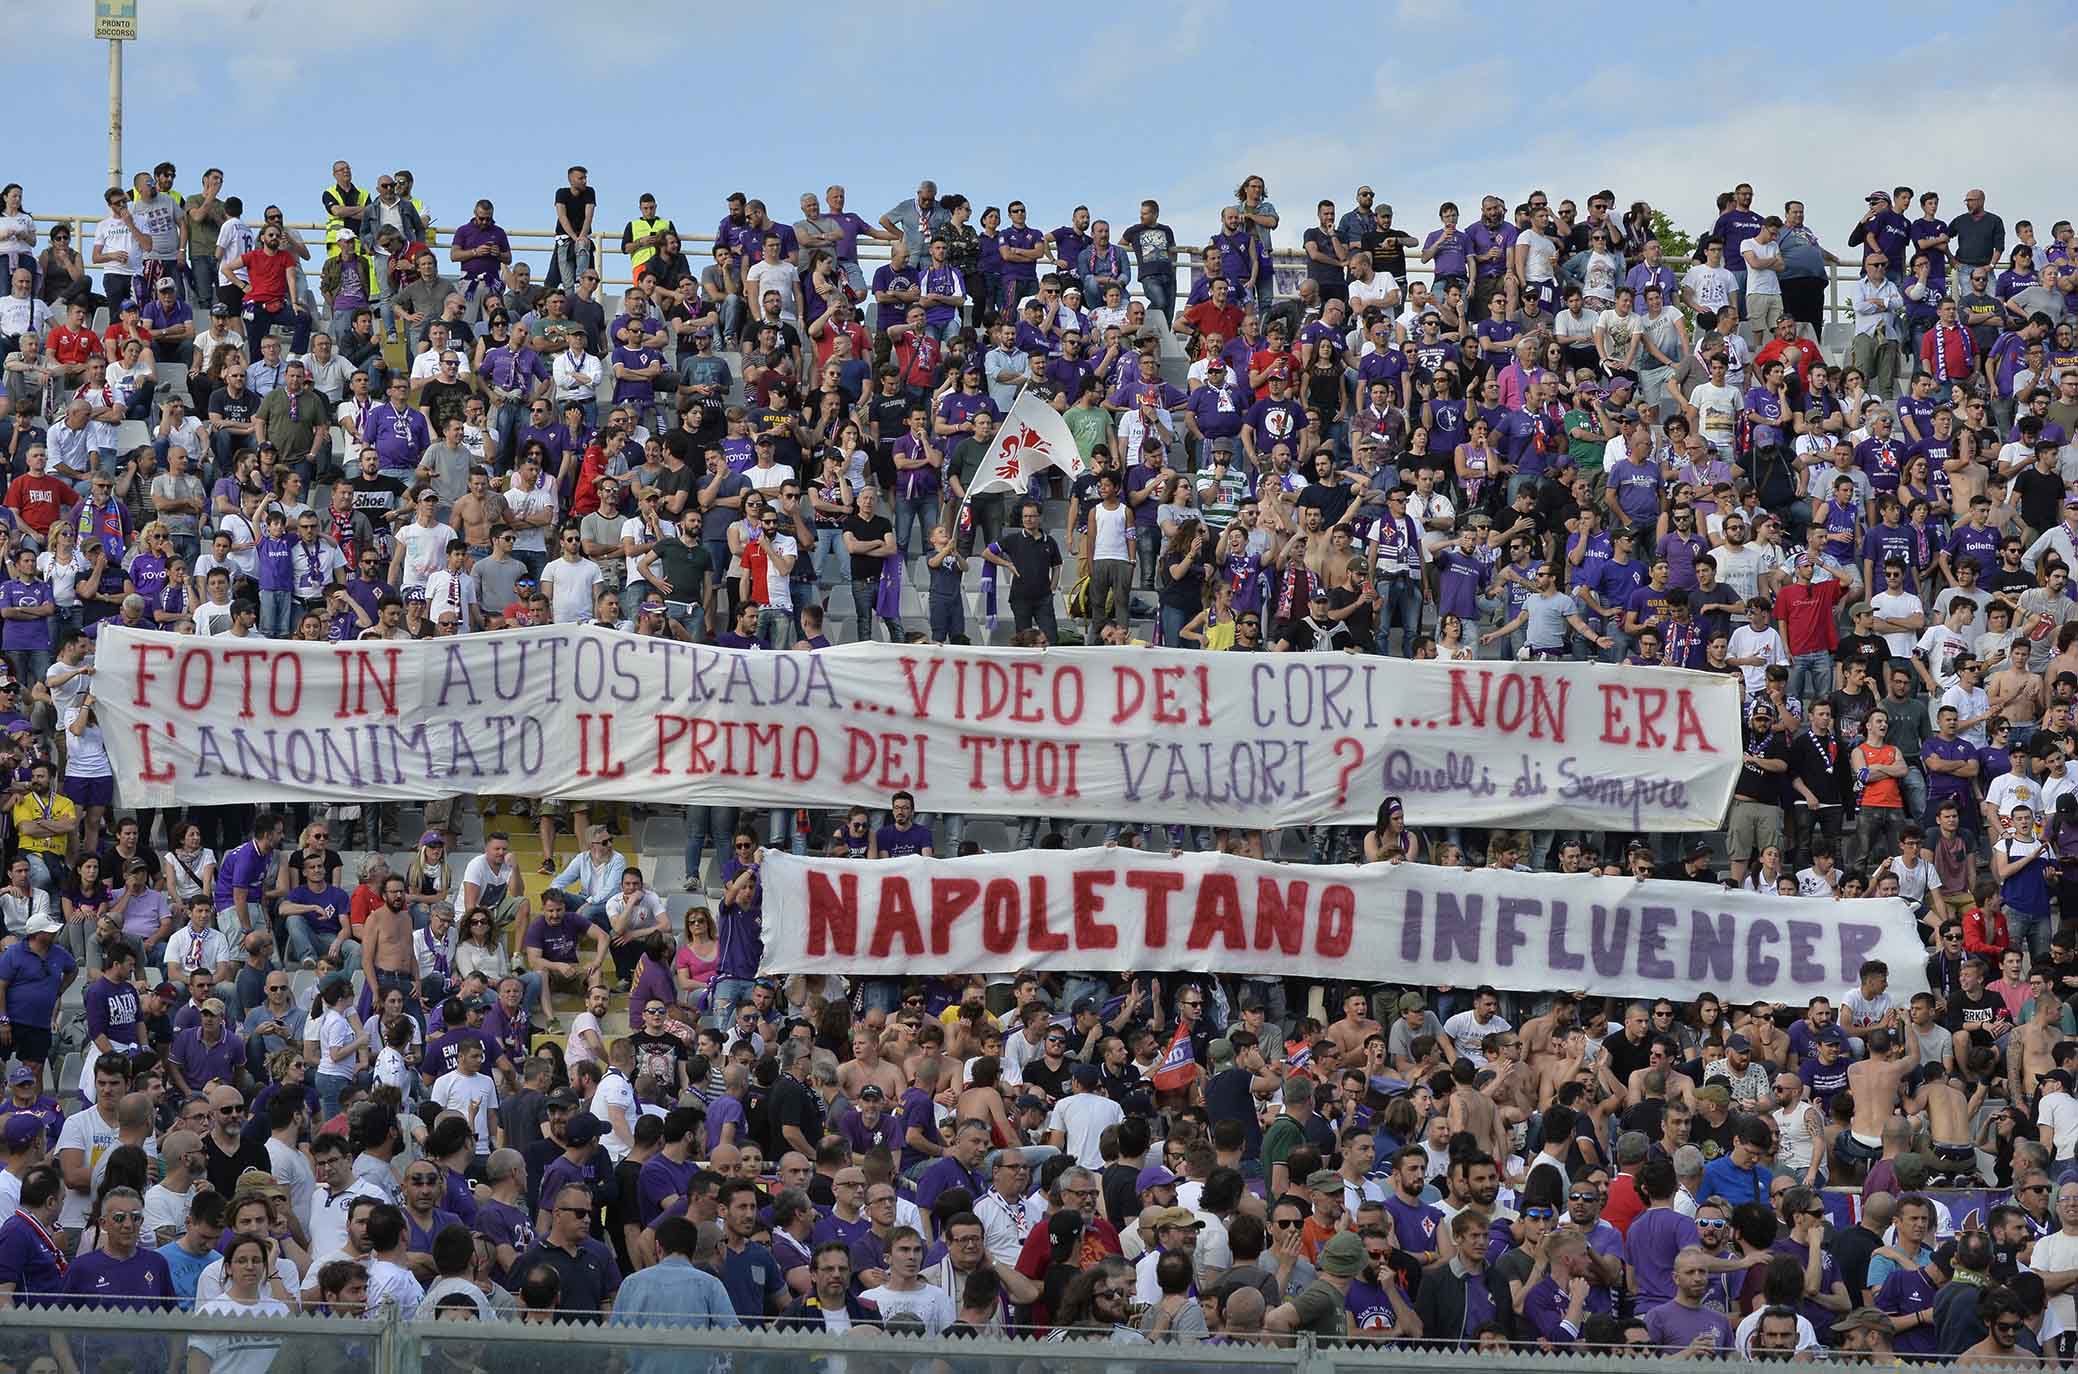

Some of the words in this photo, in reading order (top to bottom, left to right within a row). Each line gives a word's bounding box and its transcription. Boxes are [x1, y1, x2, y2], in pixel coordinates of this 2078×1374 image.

[97, 28, 135, 37] SOCCORSO
[102, 20, 130, 28] PRONTO
[131, 643, 302, 718] FOTO
[334, 647, 403, 718] IN
[1112, 665, 1213, 727] DEI
[1597, 684, 1720, 752] ERA
[132, 715, 544, 787] L'ANONIMATO
[575, 713, 625, 778] IL
[653, 714, 820, 781] PRIMO
[842, 726, 929, 790] DEI
[959, 735, 1081, 799] TUOI
[1383, 749, 1496, 798] Quelli
[1509, 754, 1547, 798] di
[1556, 756, 1689, 831] Sempre
[806, 869, 1356, 958] NAPOLETANO
[1400, 889, 1882, 987] INFLUENCER
